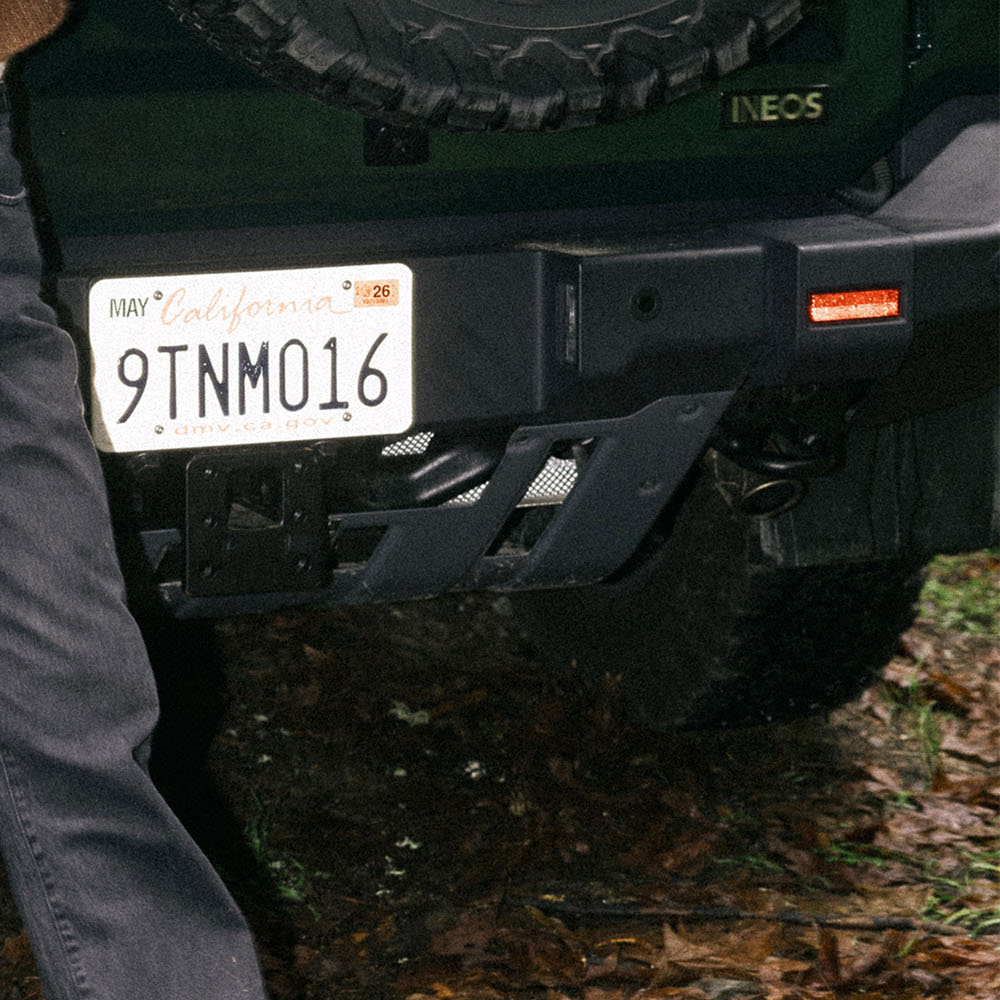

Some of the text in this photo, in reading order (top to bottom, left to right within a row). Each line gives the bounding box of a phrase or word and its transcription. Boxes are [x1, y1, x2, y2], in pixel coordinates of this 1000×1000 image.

[731, 92, 823, 122] INEOS
[373, 285, 390, 298] 26
[110, 297, 149, 318] MAY
[159, 287, 353, 334] California
[117, 332, 388, 424] 9TNM016
[174, 415, 335, 437] dmv.ca.gov
